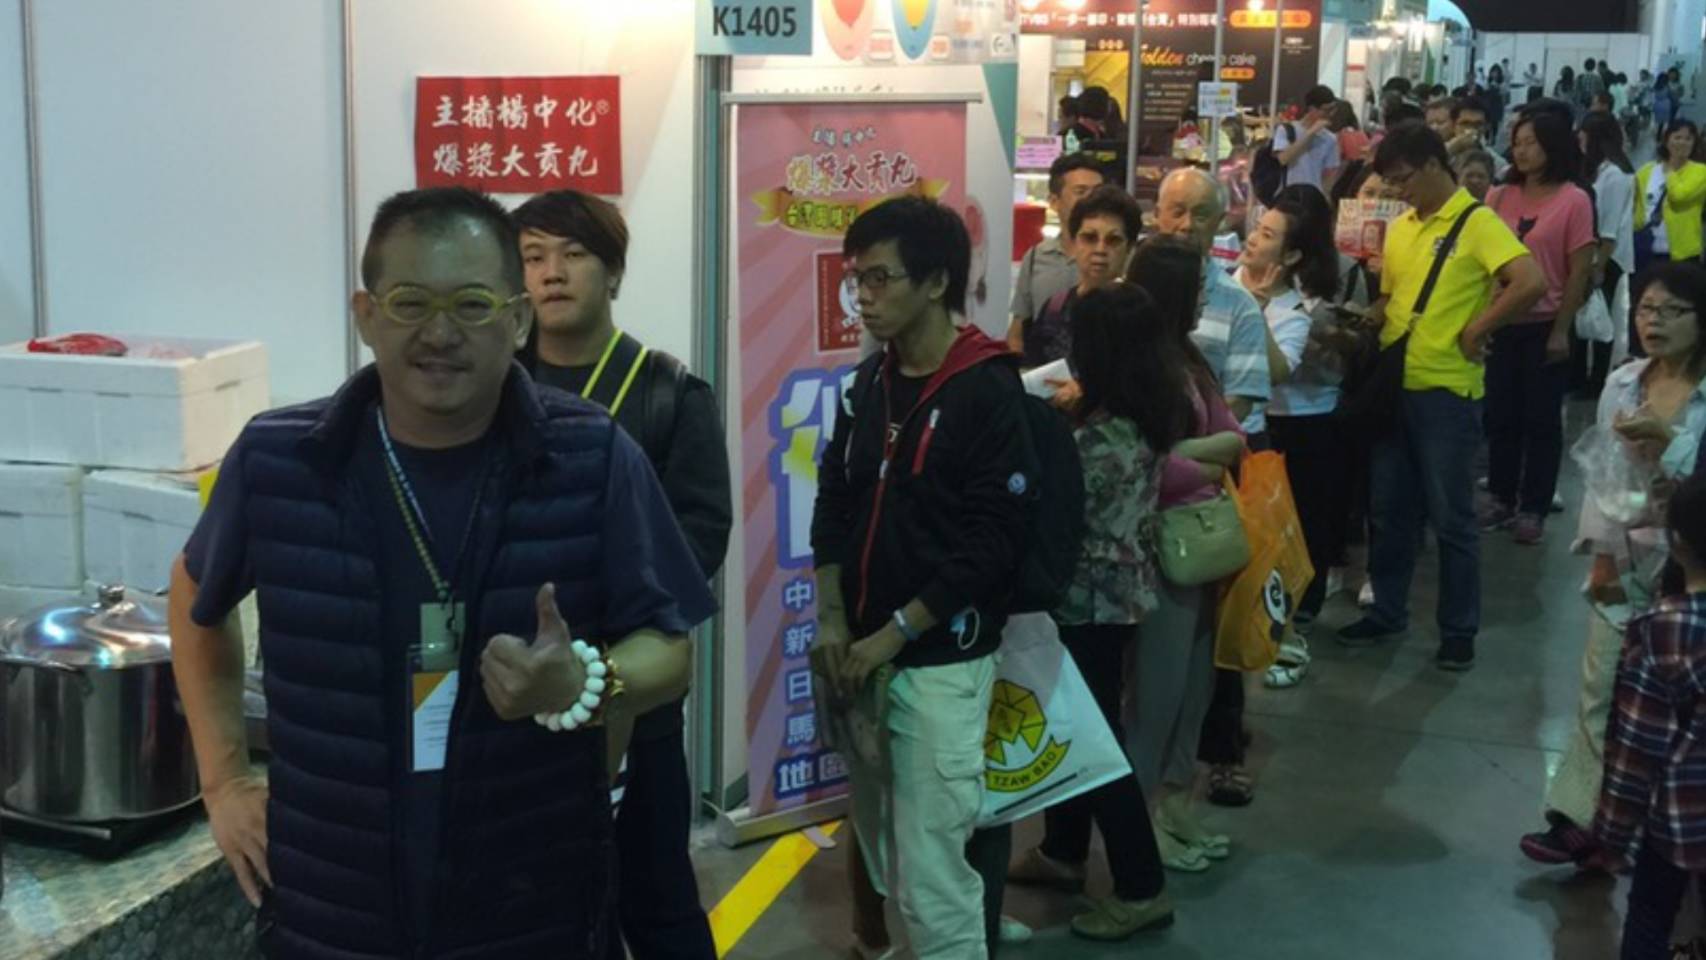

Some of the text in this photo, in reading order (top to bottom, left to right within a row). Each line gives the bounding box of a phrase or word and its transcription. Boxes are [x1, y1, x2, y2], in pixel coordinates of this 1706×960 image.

[713, 6, 797, 37] K1405
[433, 141, 598, 178] 爆漿大貢丸
[786, 151, 918, 196] 爆漿大貢丸
[993, 751, 1057, 787] TZAW BAO
